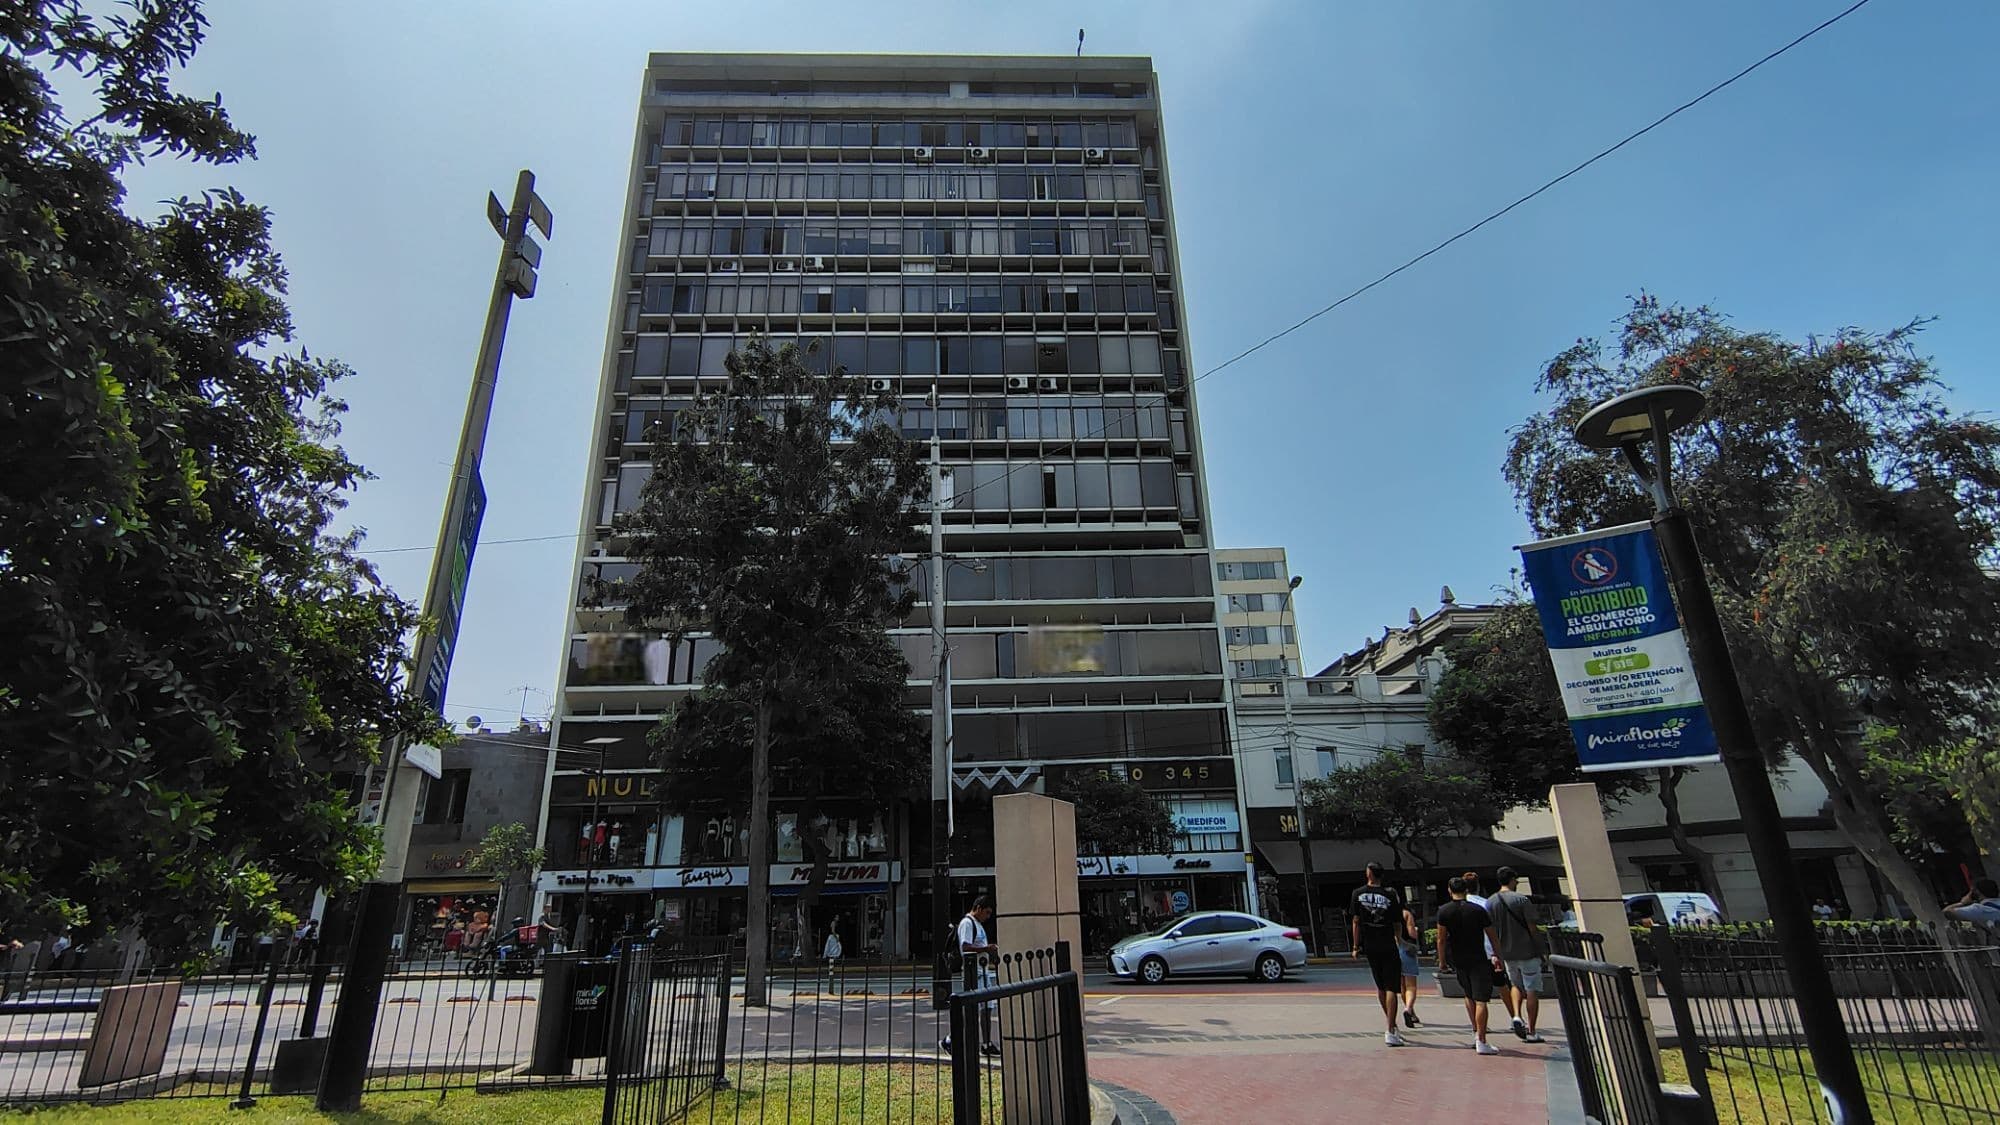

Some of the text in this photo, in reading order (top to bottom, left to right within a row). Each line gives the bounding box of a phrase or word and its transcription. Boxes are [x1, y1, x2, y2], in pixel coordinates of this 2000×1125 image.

[1560, 586, 1648, 617] PROHIBIDO
[1567, 606, 1649, 627] EL COMERCIO
[1567, 613, 1656, 636] AMBULATORIO
[1583, 627, 1642, 641] INFORMAL
[1593, 648, 1621, 658] Multa
[1566, 666, 1684, 689] DECOMISO Y/O RETENCIÓN
[1602, 678, 1662, 692] MERCADERÍA
[1588, 726, 1682, 749] miraflores
[1165, 766, 1209, 780] 345
[1187, 816, 1226, 826] MEDIFON
[557, 874, 635, 887] Tabao Pipa
